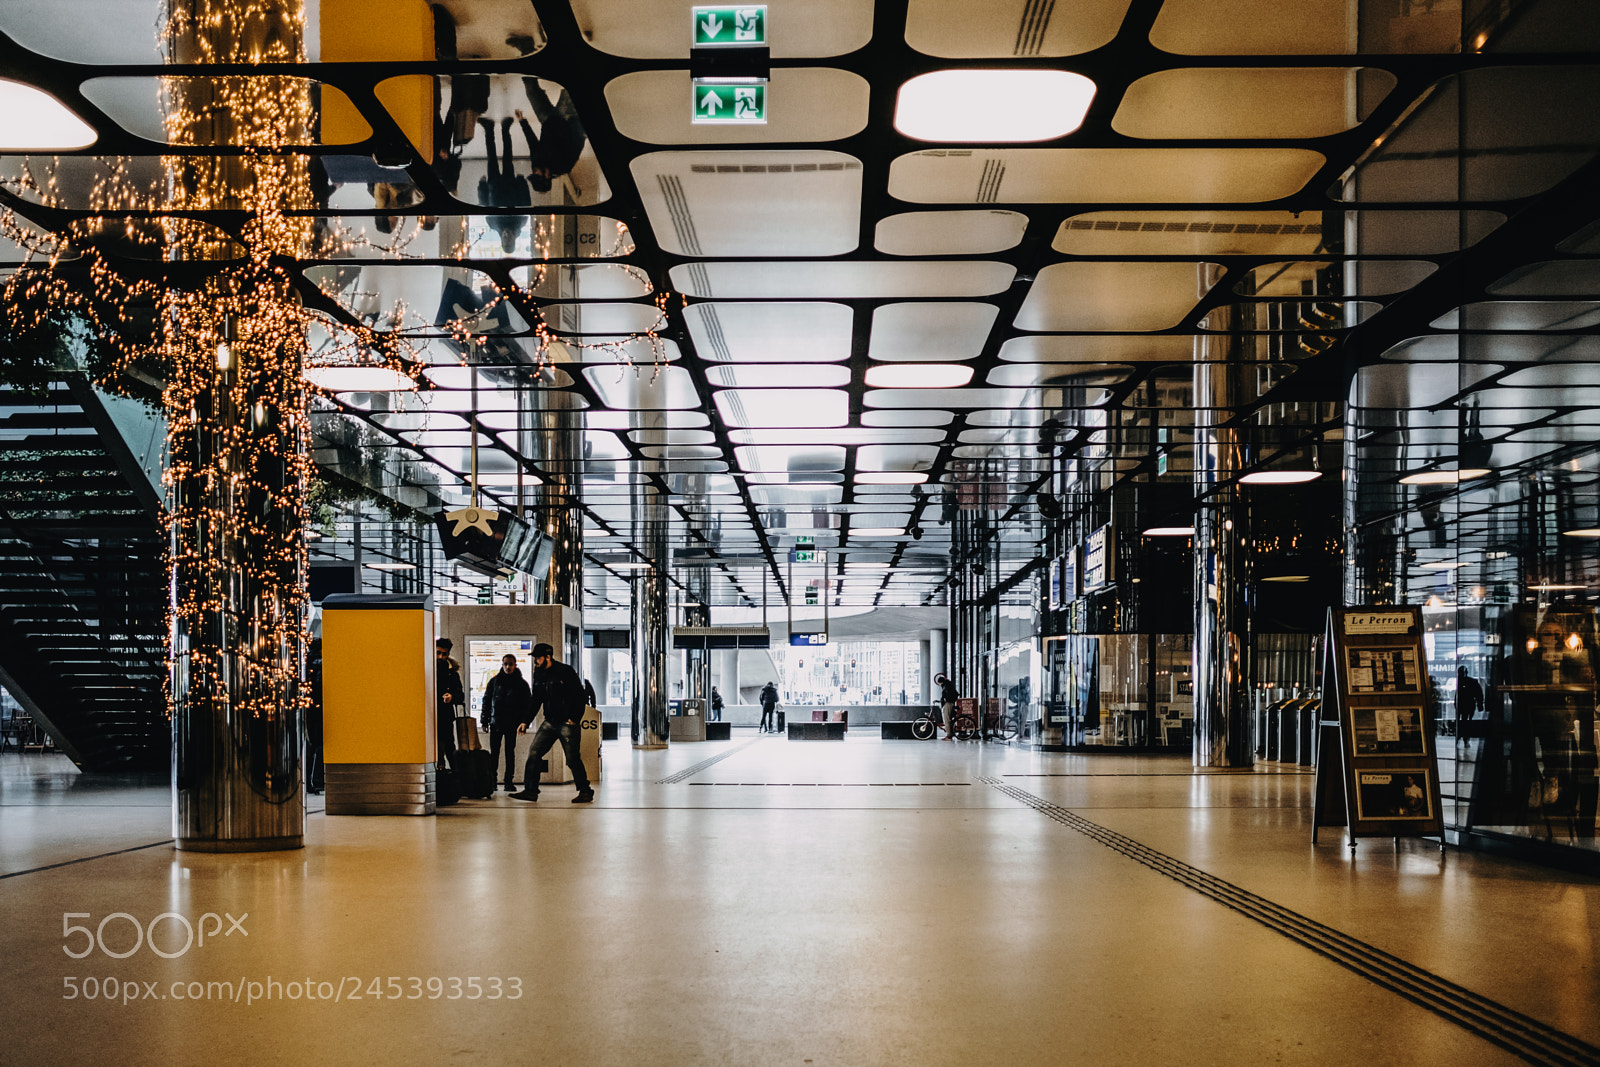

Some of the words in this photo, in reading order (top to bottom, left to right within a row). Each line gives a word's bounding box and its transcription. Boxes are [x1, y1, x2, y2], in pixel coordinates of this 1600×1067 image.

[1351, 616, 1364, 624] Le
[1369, 616, 1406, 624] Perron
[581, 719, 598, 730] CS
